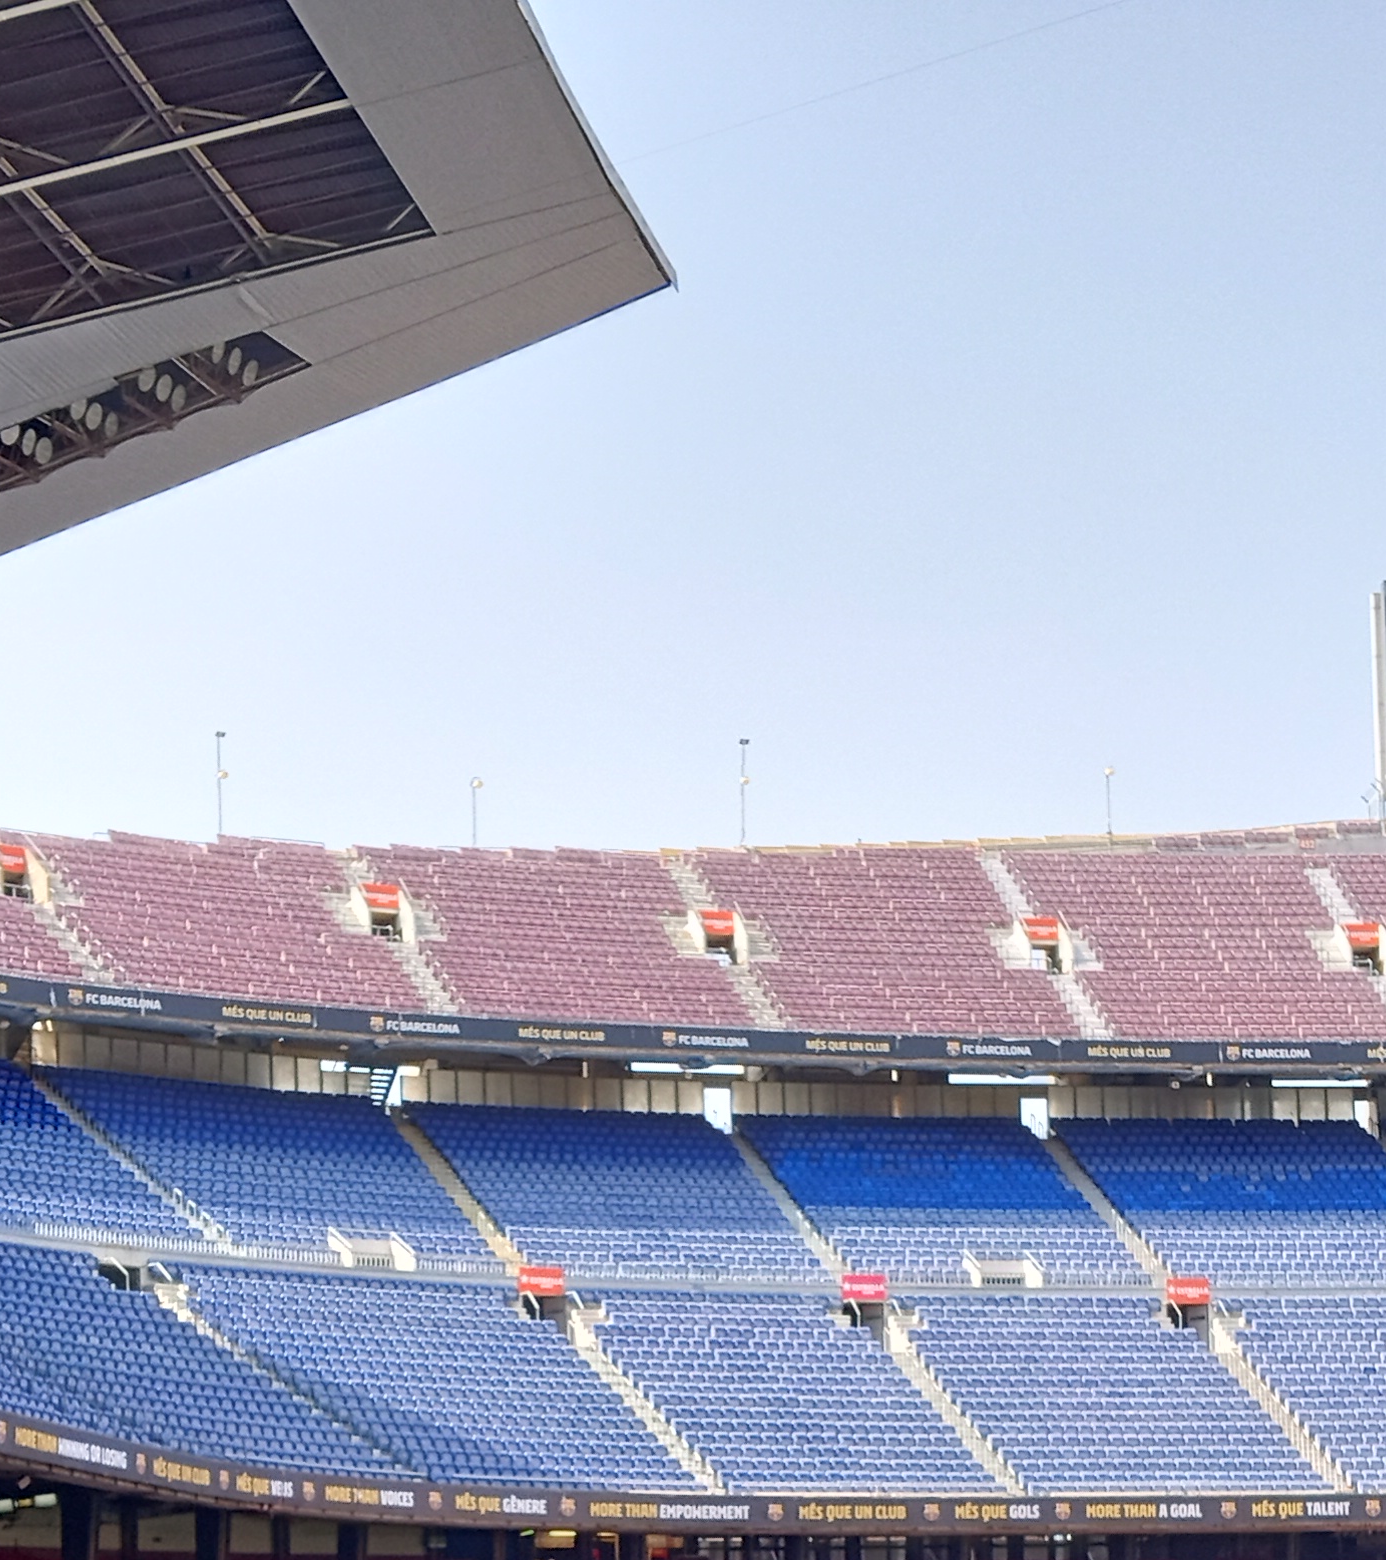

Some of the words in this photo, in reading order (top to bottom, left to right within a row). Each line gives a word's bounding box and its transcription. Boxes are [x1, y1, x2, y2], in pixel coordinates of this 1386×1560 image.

[86, 993, 98, 1004] FC
[99, 994, 161, 1010] BARCELONA
[222, 1005, 244, 1018] MÉS
[246, 1008, 267, 1021] QUE
[268, 1011, 283, 1021] UN
[285, 1012, 311, 1024] CLUB
[386, 1021, 399, 1031] FC
[400, 1021, 460, 1034] BARCELONA
[518, 1026, 539, 1039] MÉS
[541, 1029, 561, 1041] QUE
[563, 1031, 578, 1040] UN
[579, 1031, 605, 1042] CLUB
[678, 1035, 691, 1045] FC
[691, 1036, 750, 1048] BARCELONA
[805, 1038, 826, 1051] MÉS
[828, 1042, 848, 1052] QUE
[849, 1041, 863, 1051] UN
[864, 1042, 890, 1053] CLUB
[962, 1045, 975, 1055] FC
[976, 1045, 1032, 1056] BARCELONA
[1087, 1045, 1108, 1058] MÉS
[1110, 1047, 1129, 1059] QUE
[1131, 1047, 1145, 1057] UN
[1146, 1047, 1171, 1058] CLUB
[1242, 1047, 1255, 1058] FC
[1256, 1047, 1311, 1059] BARCELONA
[325, 1485, 352, 1502] MORE
[380, 1490, 413, 1507] VOICES
[456, 1492, 476, 1511] MÉS
[478, 1496, 501, 1514] QUE
[503, 1495, 547, 1514] GÈNERE
[589, 1502, 623, 1518] MORE
[625, 1503, 657, 1518] THAN
[659, 1504, 750, 1520] EMPOWERMENT
[799, 1502, 824, 1520] MÉS
[826, 1505, 852, 1522] QUE
[855, 1505, 873, 1519] UN
[875, 1505, 907, 1519] CLUB
[954, 1502, 980, 1520] MÉS
[982, 1505, 1007, 1522] QUE
[1009, 1504, 1040, 1519] GOLS
[1086, 1503, 1121, 1518] MORE
[1124, 1503, 1157, 1518] THAN
[1159, 1504, 1168, 1518] A
[1169, 1503, 1202, 1518] GOAL
[1252, 1500, 1274, 1517] MÉS
[1278, 1503, 1303, 1520] QUE
[1305, 1501, 1350, 1516] TALENT
